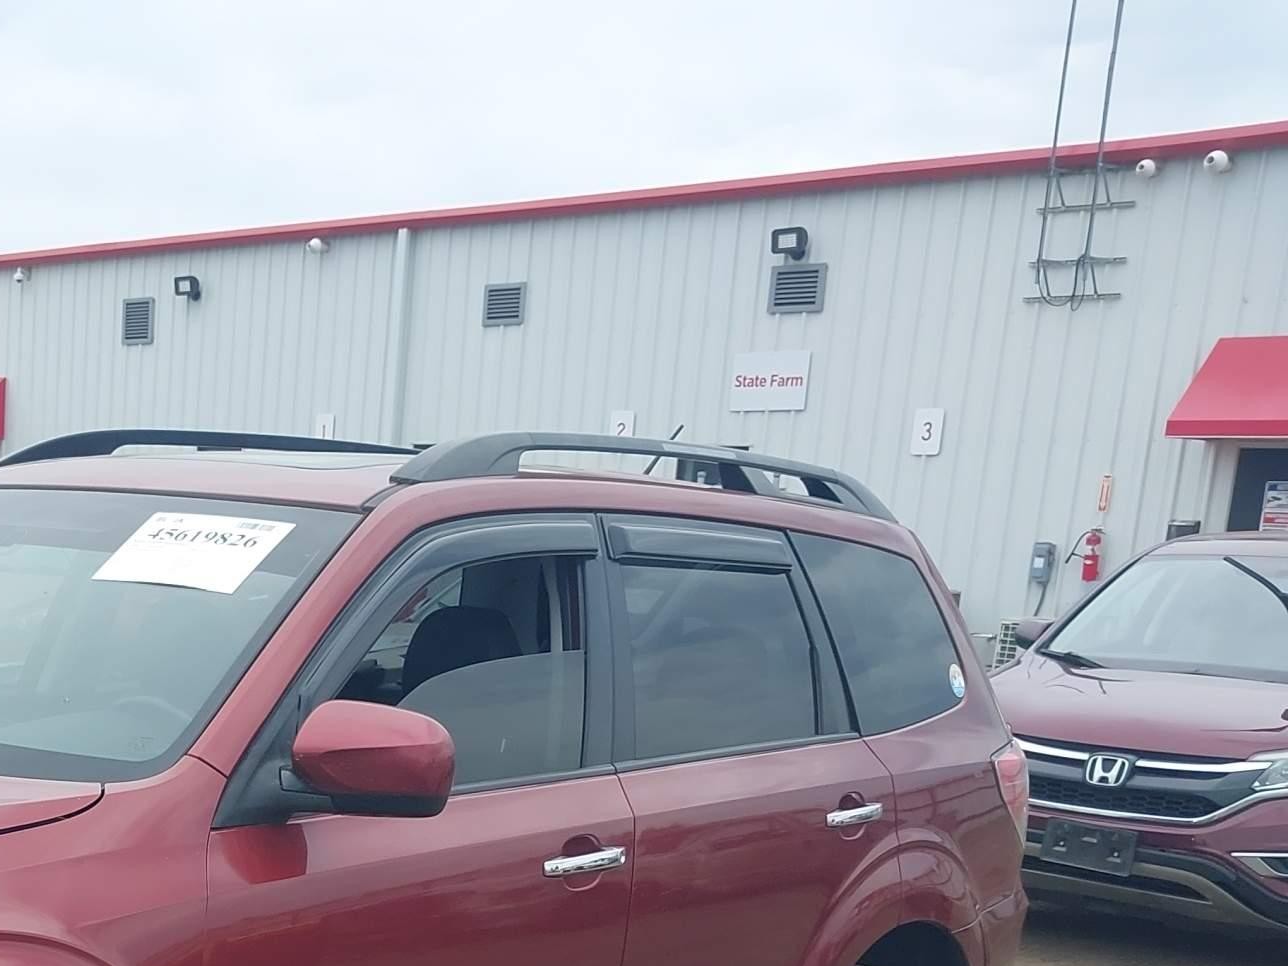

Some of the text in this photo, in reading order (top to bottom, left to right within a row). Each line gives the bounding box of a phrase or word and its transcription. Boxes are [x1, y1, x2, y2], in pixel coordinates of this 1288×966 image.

[734, 374, 804, 388] State Farm
[616, 421, 627, 437] 2
[921, 421, 933, 441] 3
[148, 527, 258, 548] 45619826
